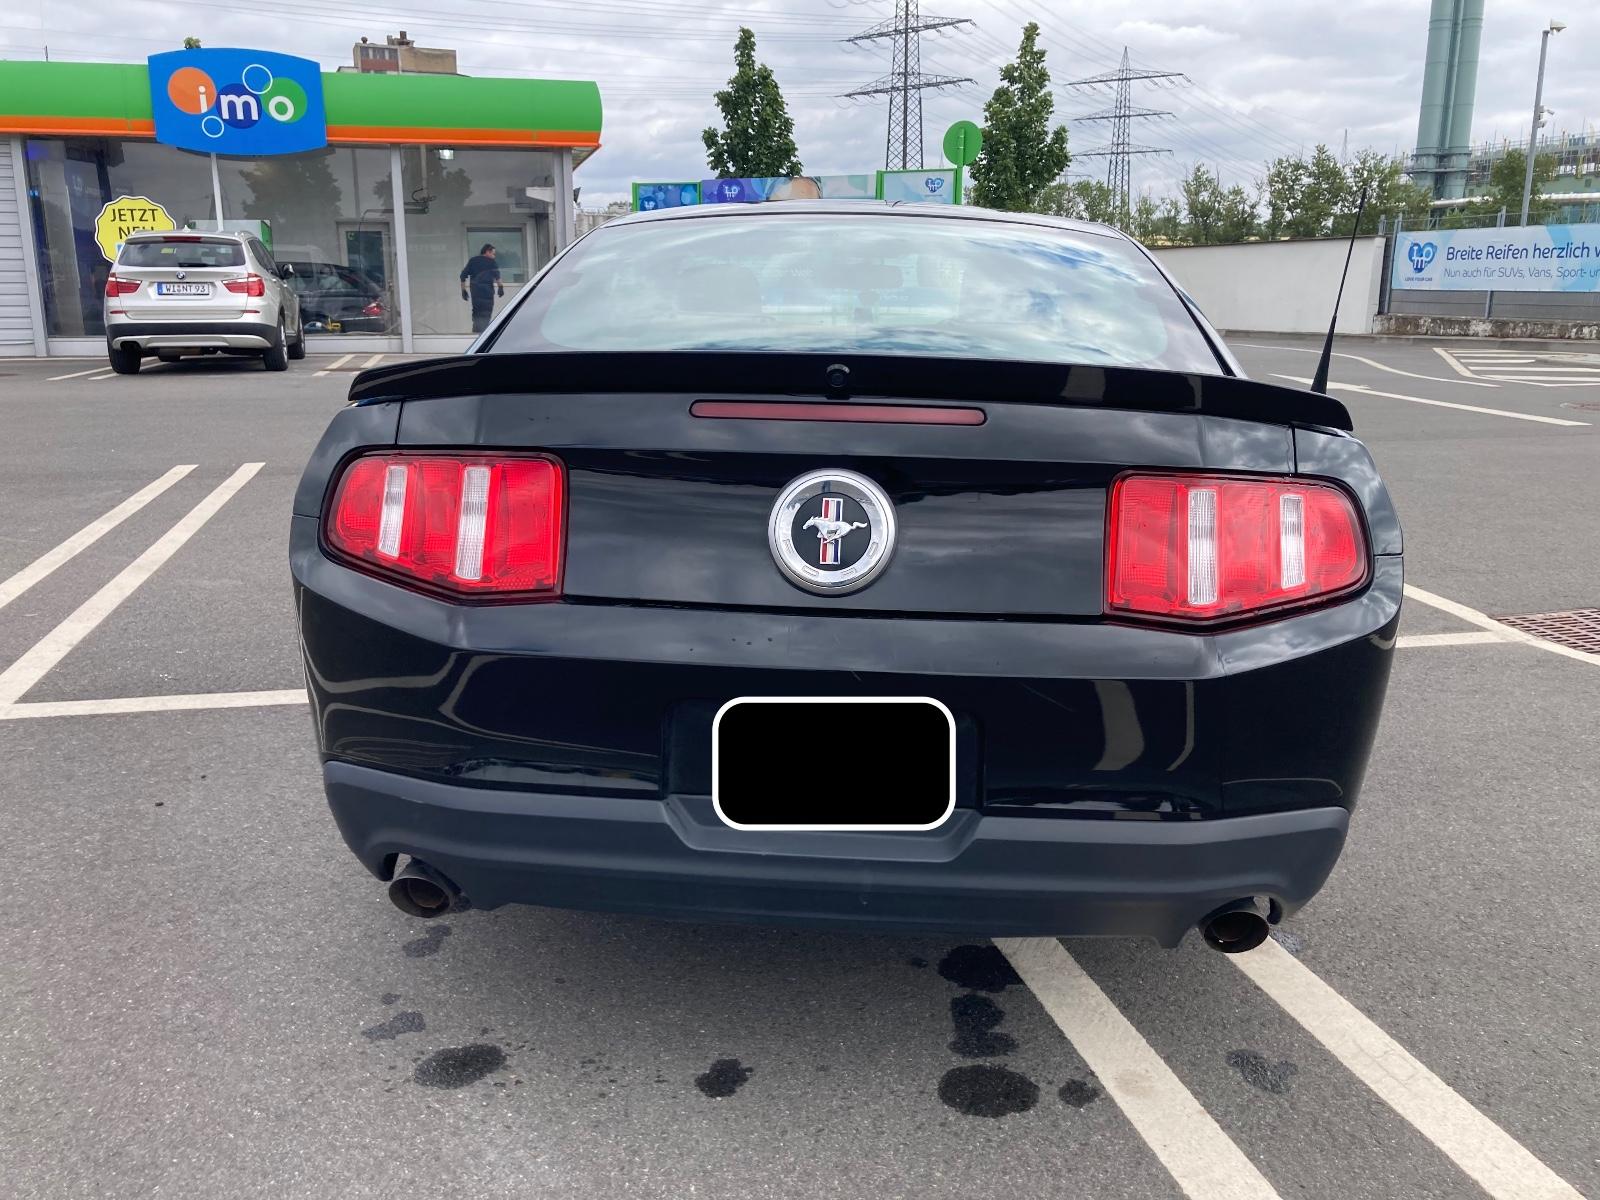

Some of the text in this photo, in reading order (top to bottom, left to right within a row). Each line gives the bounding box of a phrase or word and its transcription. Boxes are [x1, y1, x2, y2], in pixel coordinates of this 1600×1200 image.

[198, 85, 294, 122] imo
[110, 208, 158, 222] JETZT
[1446, 245, 1483, 260] Breite
[1486, 244, 1528, 259] Reifen
[1532, 242, 1590, 259] herzlich
[1444, 268, 1461, 278] Nun
[1463, 267, 1482, 278] auch
[1484, 266, 1496, 278] für
[1497, 267, 1525, 279] SUVs,
[1528, 266, 1552, 279] Vans,
[1556, 266, 1587, 280] Sport-
